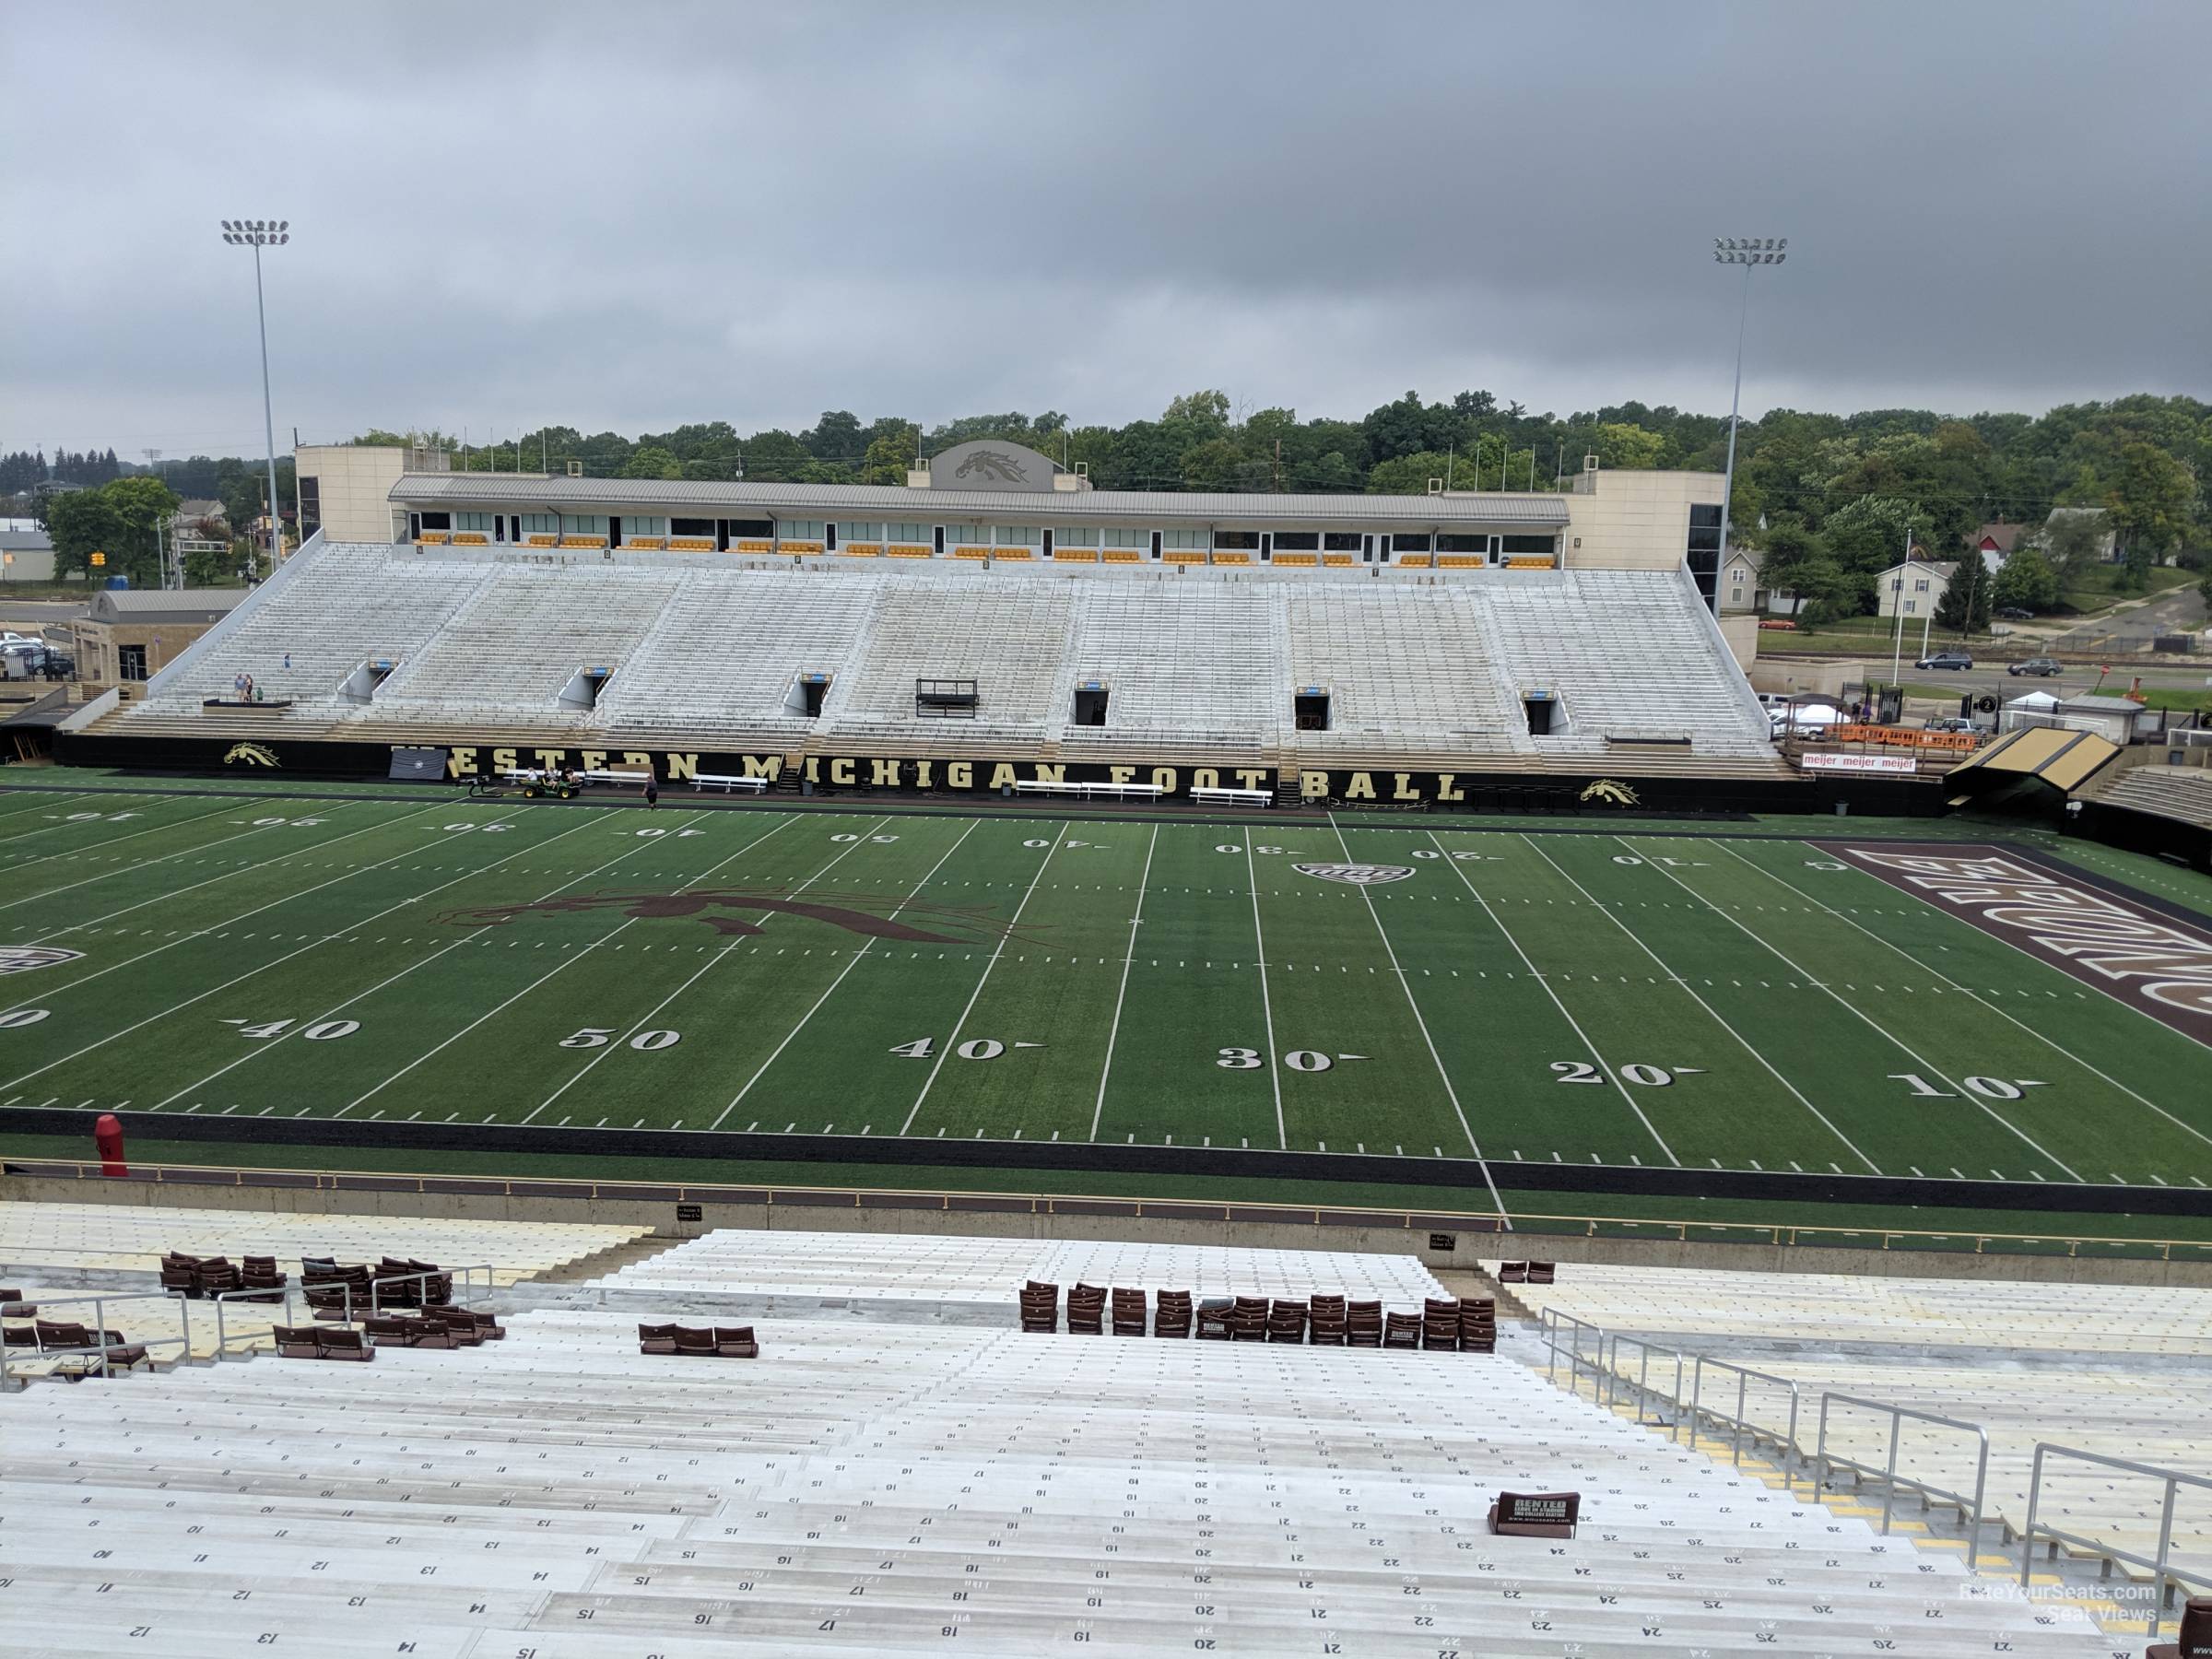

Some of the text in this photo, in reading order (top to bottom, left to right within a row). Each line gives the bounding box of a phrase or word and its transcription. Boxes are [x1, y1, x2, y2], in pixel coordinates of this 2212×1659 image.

[1805, 754, 1914, 770] meijer meijer meijer
[238, 1018, 361, 1041] 40
[559, 1028, 681, 1051] 50
[888, 1038, 1005, 1060] 40
[1217, 1048, 1333, 1073] 30
[1549, 1062, 1674, 1087] 20
[1888, 1074, 2025, 1100] 10
[1515, 1500, 1567, 1508] RENTED
[92, 1549, 113, 1559] 10
[193, 1554, 209, 1563] 11
[682, 1550, 697, 1559] 15
[1291, 1554, 1304, 1562] 21
[777, 1556, 792, 1565] 16
[878, 1560, 893, 1570] 17
[1382, 1559, 1400, 1567] 22
[1825, 1559, 1839, 1568] 27
[311, 1561, 330, 1571] 12
[419, 1566, 438, 1575] 13
[965, 1564, 979, 1573] 18
[1477, 1563, 1496, 1571] 23
[532, 1571, 549, 1582] 14
[1095, 1570, 1110, 1579] 19
[1574, 1568, 1592, 1576] 24
[633, 1576, 651, 1586] 15
[1194, 1574, 1212, 1584] 20
[1766, 1578, 1786, 1586] 26
[96, 1583, 114, 1594] 11
[738, 1582, 754, 1592] 16
[849, 1585, 865, 1595] 17
[1299, 1581, 1313, 1589] 21
[1403, 1585, 1421, 1595] 22
[1868, 1581, 1882, 1589] 27
[232, 1590, 252, 1601] 12
[952, 1592, 968, 1601] 18
[1503, 1590, 1522, 1599] 23
[347, 1596, 367, 1606] 13
[1087, 1597, 1102, 1607] 19
[1599, 1595, 1618, 1605] 24
[1702, 1600, 1723, 1609] 25
[468, 1603, 487, 1614] 14
[1194, 1606, 1215, 1616] 20
[1311, 1608, 1327, 1619] 21
[1812, 1605, 1833, 1614] 26
[1925, 1609, 1940, 1618] 27
[576, 1609, 594, 1620] 15
[694, 1614, 712, 1625] 16
[818, 1619, 836, 1631] 17
[1414, 1616, 1434, 1627] 22
[1531, 1620, 1552, 1631] 23
[2034, 1616, 2055, 1625] 28
[129, 1626, 152, 1638] 12
[941, 1626, 958, 1637] 18
[1074, 1631, 1090, 1642] 19
[1641, 1627, 1662, 1637] 24
[257, 1632, 279, 1644] 13
[1755, 1633, 1778, 1643] 25
[397, 1641, 418, 1653] 14
[1194, 1639, 1216, 1650] 20
[1324, 1643, 1341, 1654] 21
[1873, 1640, 1896, 1650] 26
[1994, 1641, 2013, 1652] 27
[515, 1648, 536, 1659] 15
[1438, 1650, 1458, 1659] 22
